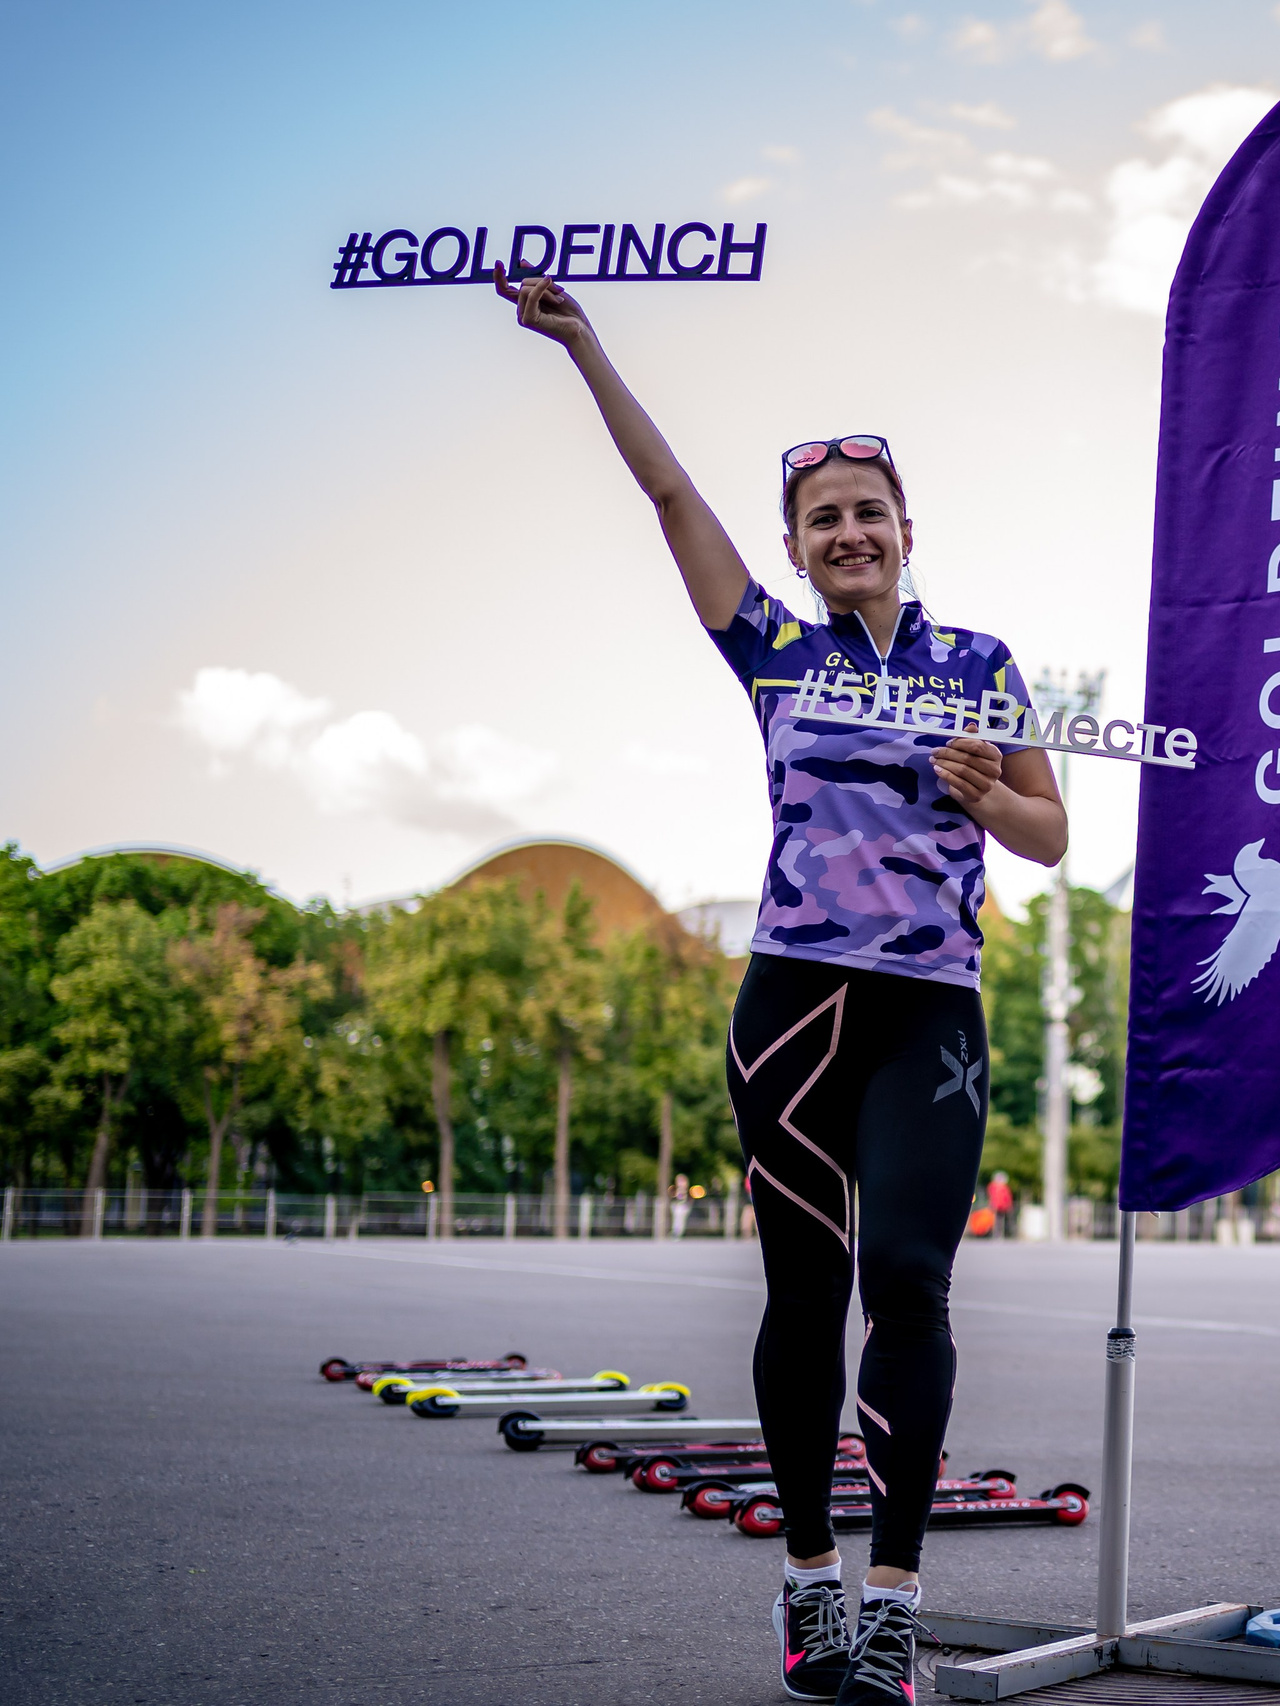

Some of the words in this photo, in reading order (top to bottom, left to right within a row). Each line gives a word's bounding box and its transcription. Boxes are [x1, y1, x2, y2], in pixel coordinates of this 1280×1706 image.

[332, 222, 768, 286] #GOLDFINCH
[825, 652, 964, 694] GDNCH
[790, 669, 1198, 765] #5ЛетВместе
